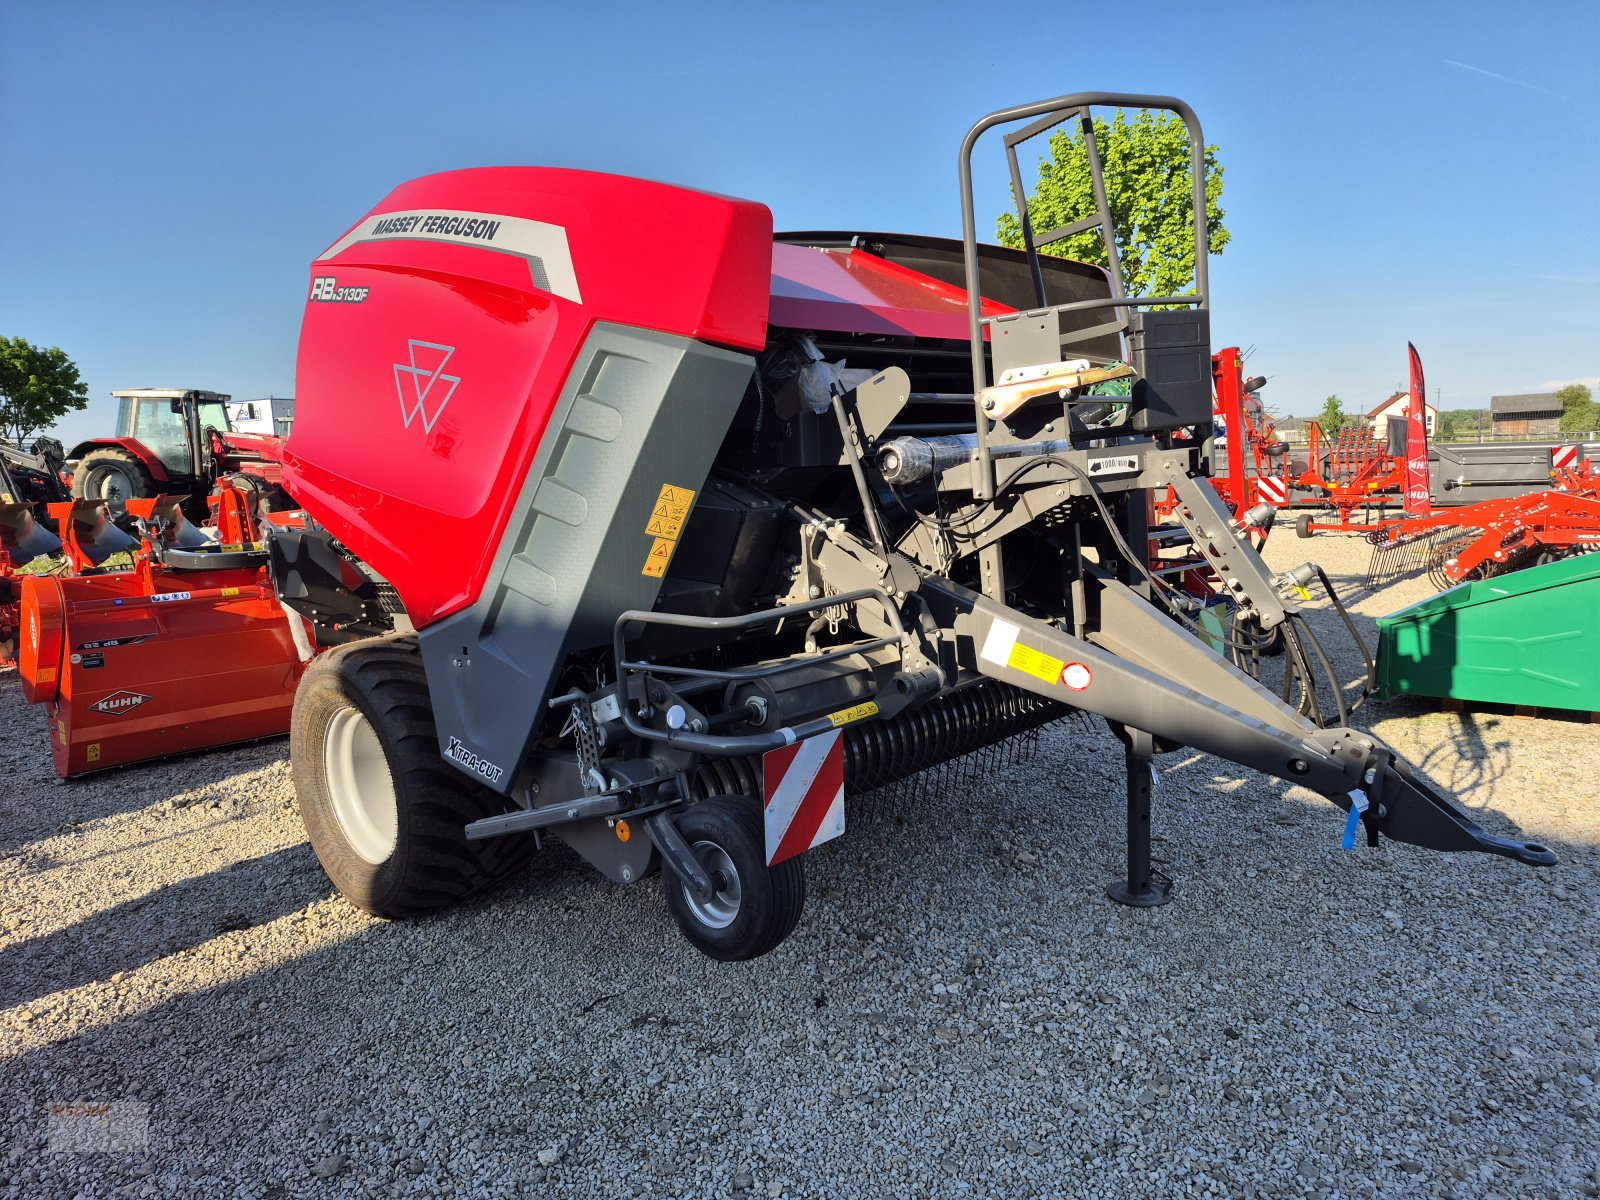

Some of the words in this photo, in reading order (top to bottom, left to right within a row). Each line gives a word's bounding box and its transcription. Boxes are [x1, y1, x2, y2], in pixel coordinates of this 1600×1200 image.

[371, 215, 424, 235] MASSEY
[419, 215, 502, 241] FERGUSON
[309, 275, 370, 304] RB.3130F
[98, 695, 143, 711] KUHN
[443, 735, 504, 783] XTRA-CUT
